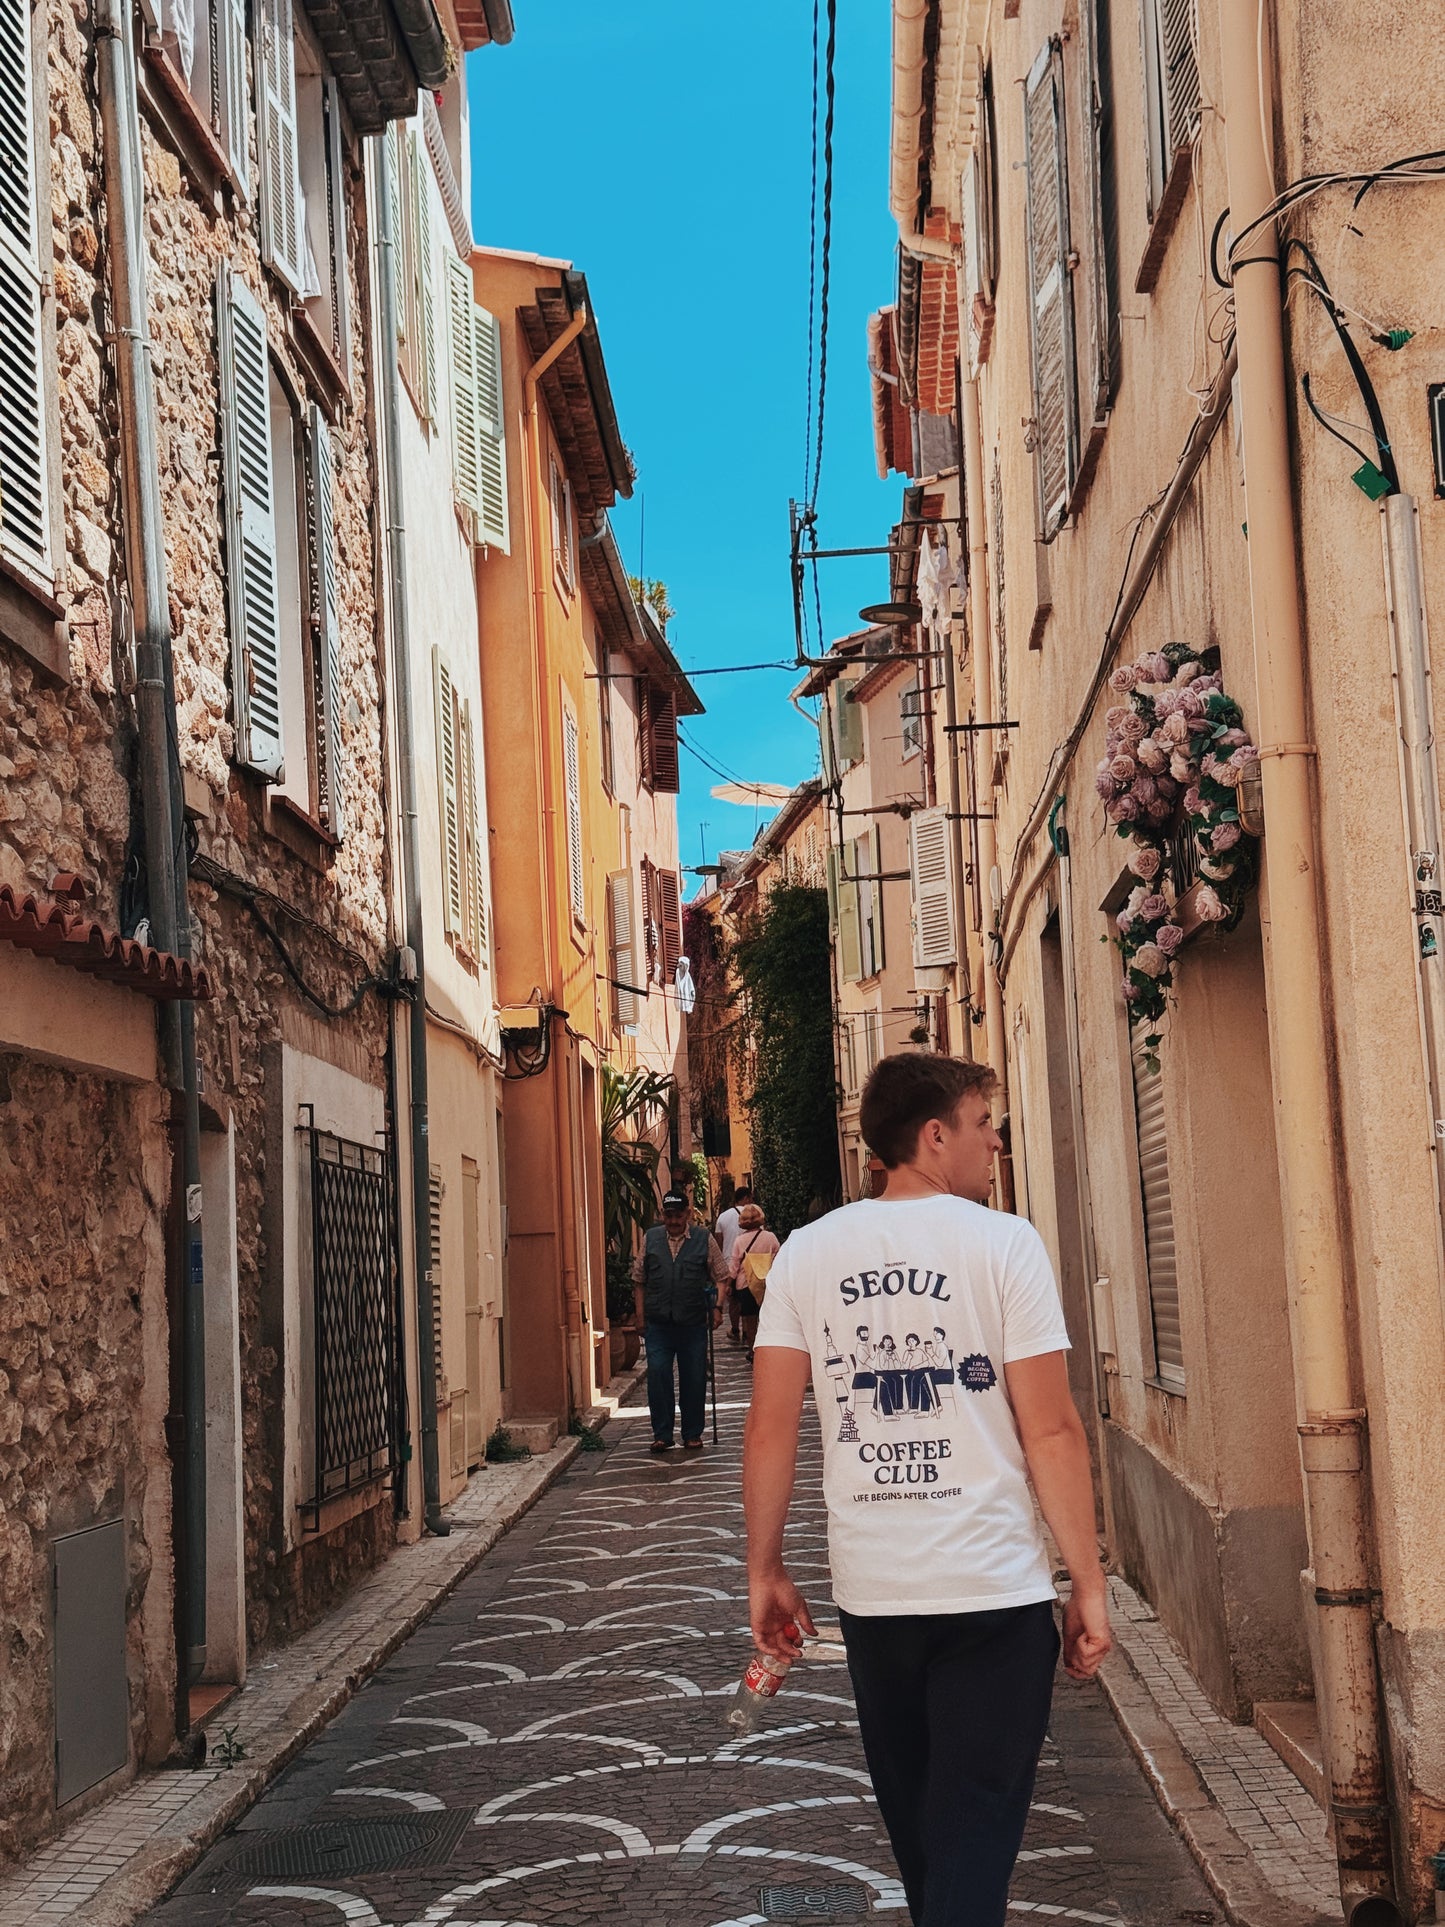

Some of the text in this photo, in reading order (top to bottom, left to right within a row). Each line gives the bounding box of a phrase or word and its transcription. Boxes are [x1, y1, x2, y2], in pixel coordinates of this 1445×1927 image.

[839, 1268, 951, 1307] SEOUL
[859, 1438, 952, 1463] COFFEE
[874, 1463, 939, 1485] CLUB
[853, 1487, 962, 1503] LIFE BEGINS AFTER COFFEE
